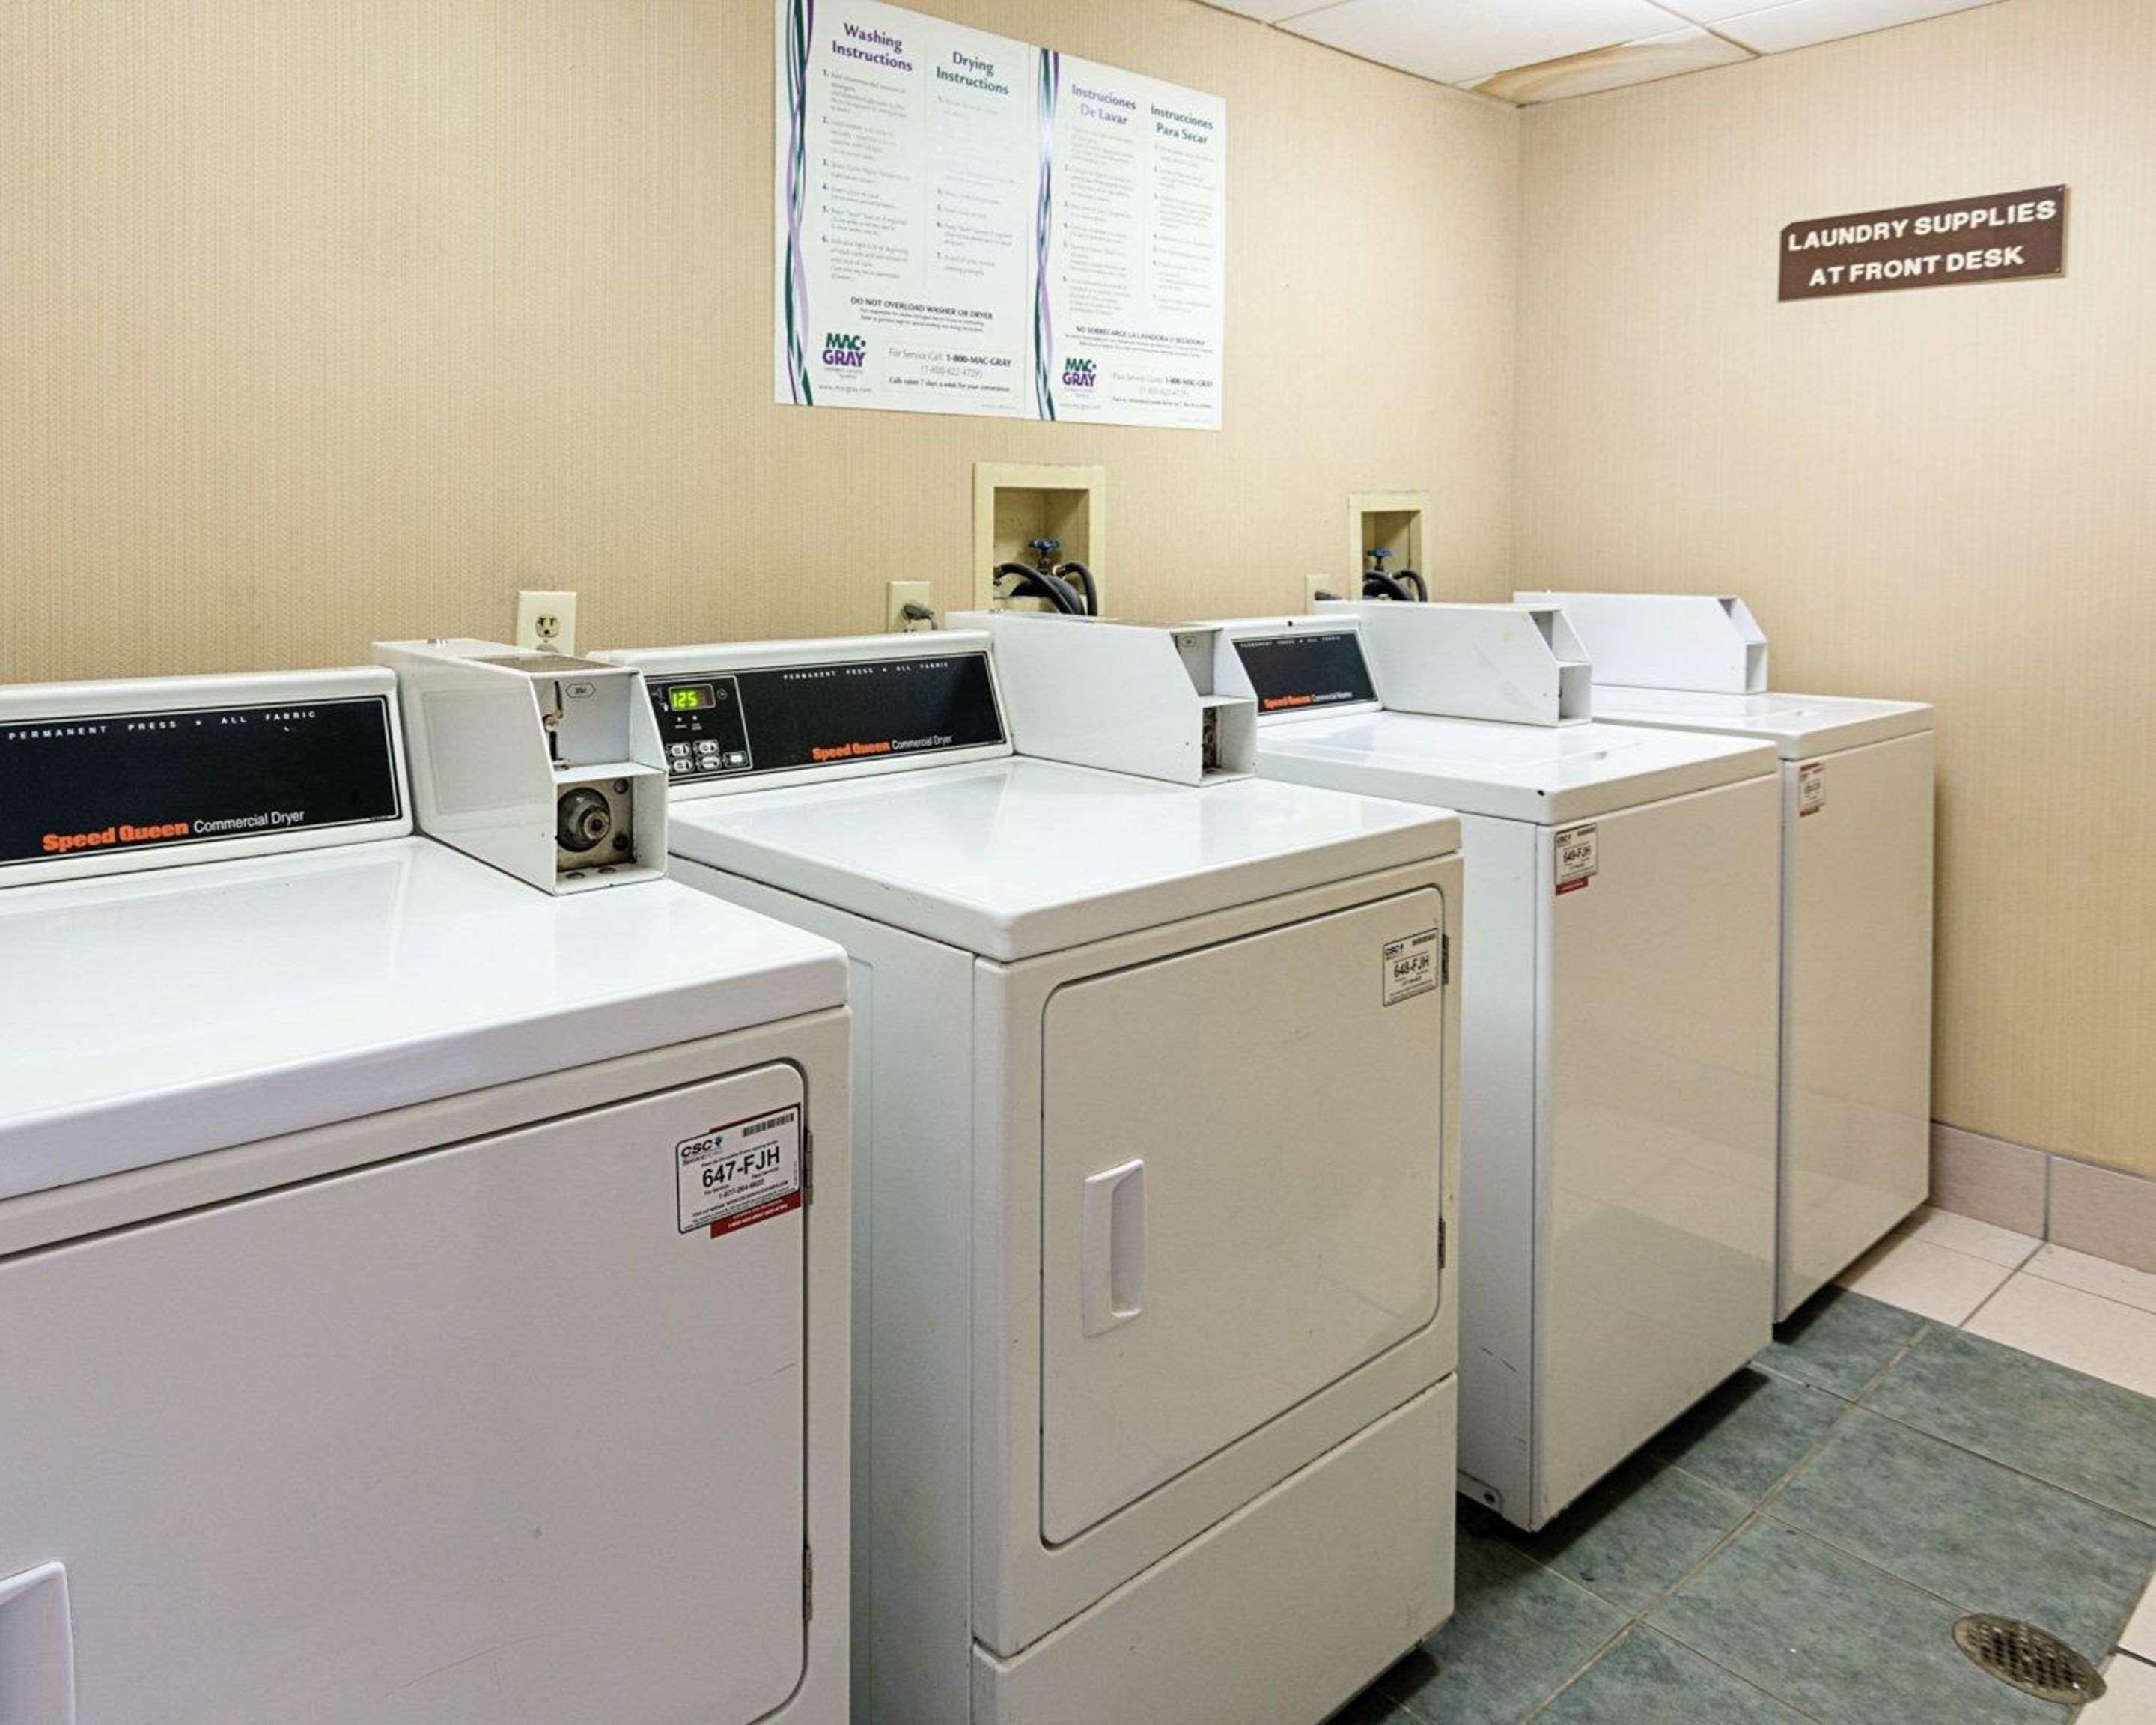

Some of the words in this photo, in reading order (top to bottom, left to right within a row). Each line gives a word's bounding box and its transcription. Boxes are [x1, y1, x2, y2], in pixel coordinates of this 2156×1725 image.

[844, 22, 903, 55] Washing
[832, 40, 913, 72] Instructions
[952, 50, 994, 77] Drying
[937, 66, 1009, 95] Instructions
[1071, 84, 1136, 110] Instruciones
[1081, 103, 1096, 116] De
[1098, 109, 1128, 125] Lavar
[1151, 103, 1213, 130] Instrucciones
[1156, 122, 1179, 138] Para
[1182, 128, 1208, 144] Secar
[1788, 218, 1910, 252] LAUNDRY
[1913, 199, 2056, 235] SUPPLIES
[1809, 264, 1846, 288] AT
[1848, 255, 1941, 282] FRONT
[1946, 245, 2025, 273] DESK
[850, 296, 863, 305] DO
[865, 298, 883, 308] NOT
[884, 300, 925, 313] OVERLOAD
[926, 305, 956, 316] WASHER
[958, 308, 969, 317] OR
[970, 310, 993, 320] DRYER
[823, 349, 867, 367] GRAY
[945, 353, 1012, 367] 1-800-MAC-GRAY
[1062, 371, 1097, 387] GRAY
[783, 670, 836, 680] PERMANENT
[846, 667, 874, 675] PRESS
[672, 690, 698, 708] 125
[8, 725, 107, 740] PERMANENT
[127, 720, 177, 731] PRESS
[221, 716, 247, 725] ALL
[265, 711, 316, 721] FABRIC
[811, 743, 852, 761] Speed
[853, 741, 892, 755] Queen
[892, 736, 933, 750] Commercial
[934, 734, 953, 746] Dryer
[42, 826, 116, 853] Speed
[118, 821, 190, 842] Queen
[193, 812, 269, 833] Commercial
[270, 809, 305, 827] Dryer
[681, 1140, 713, 1158] CSC
[702, 1146, 780, 1188] 647-FJH
